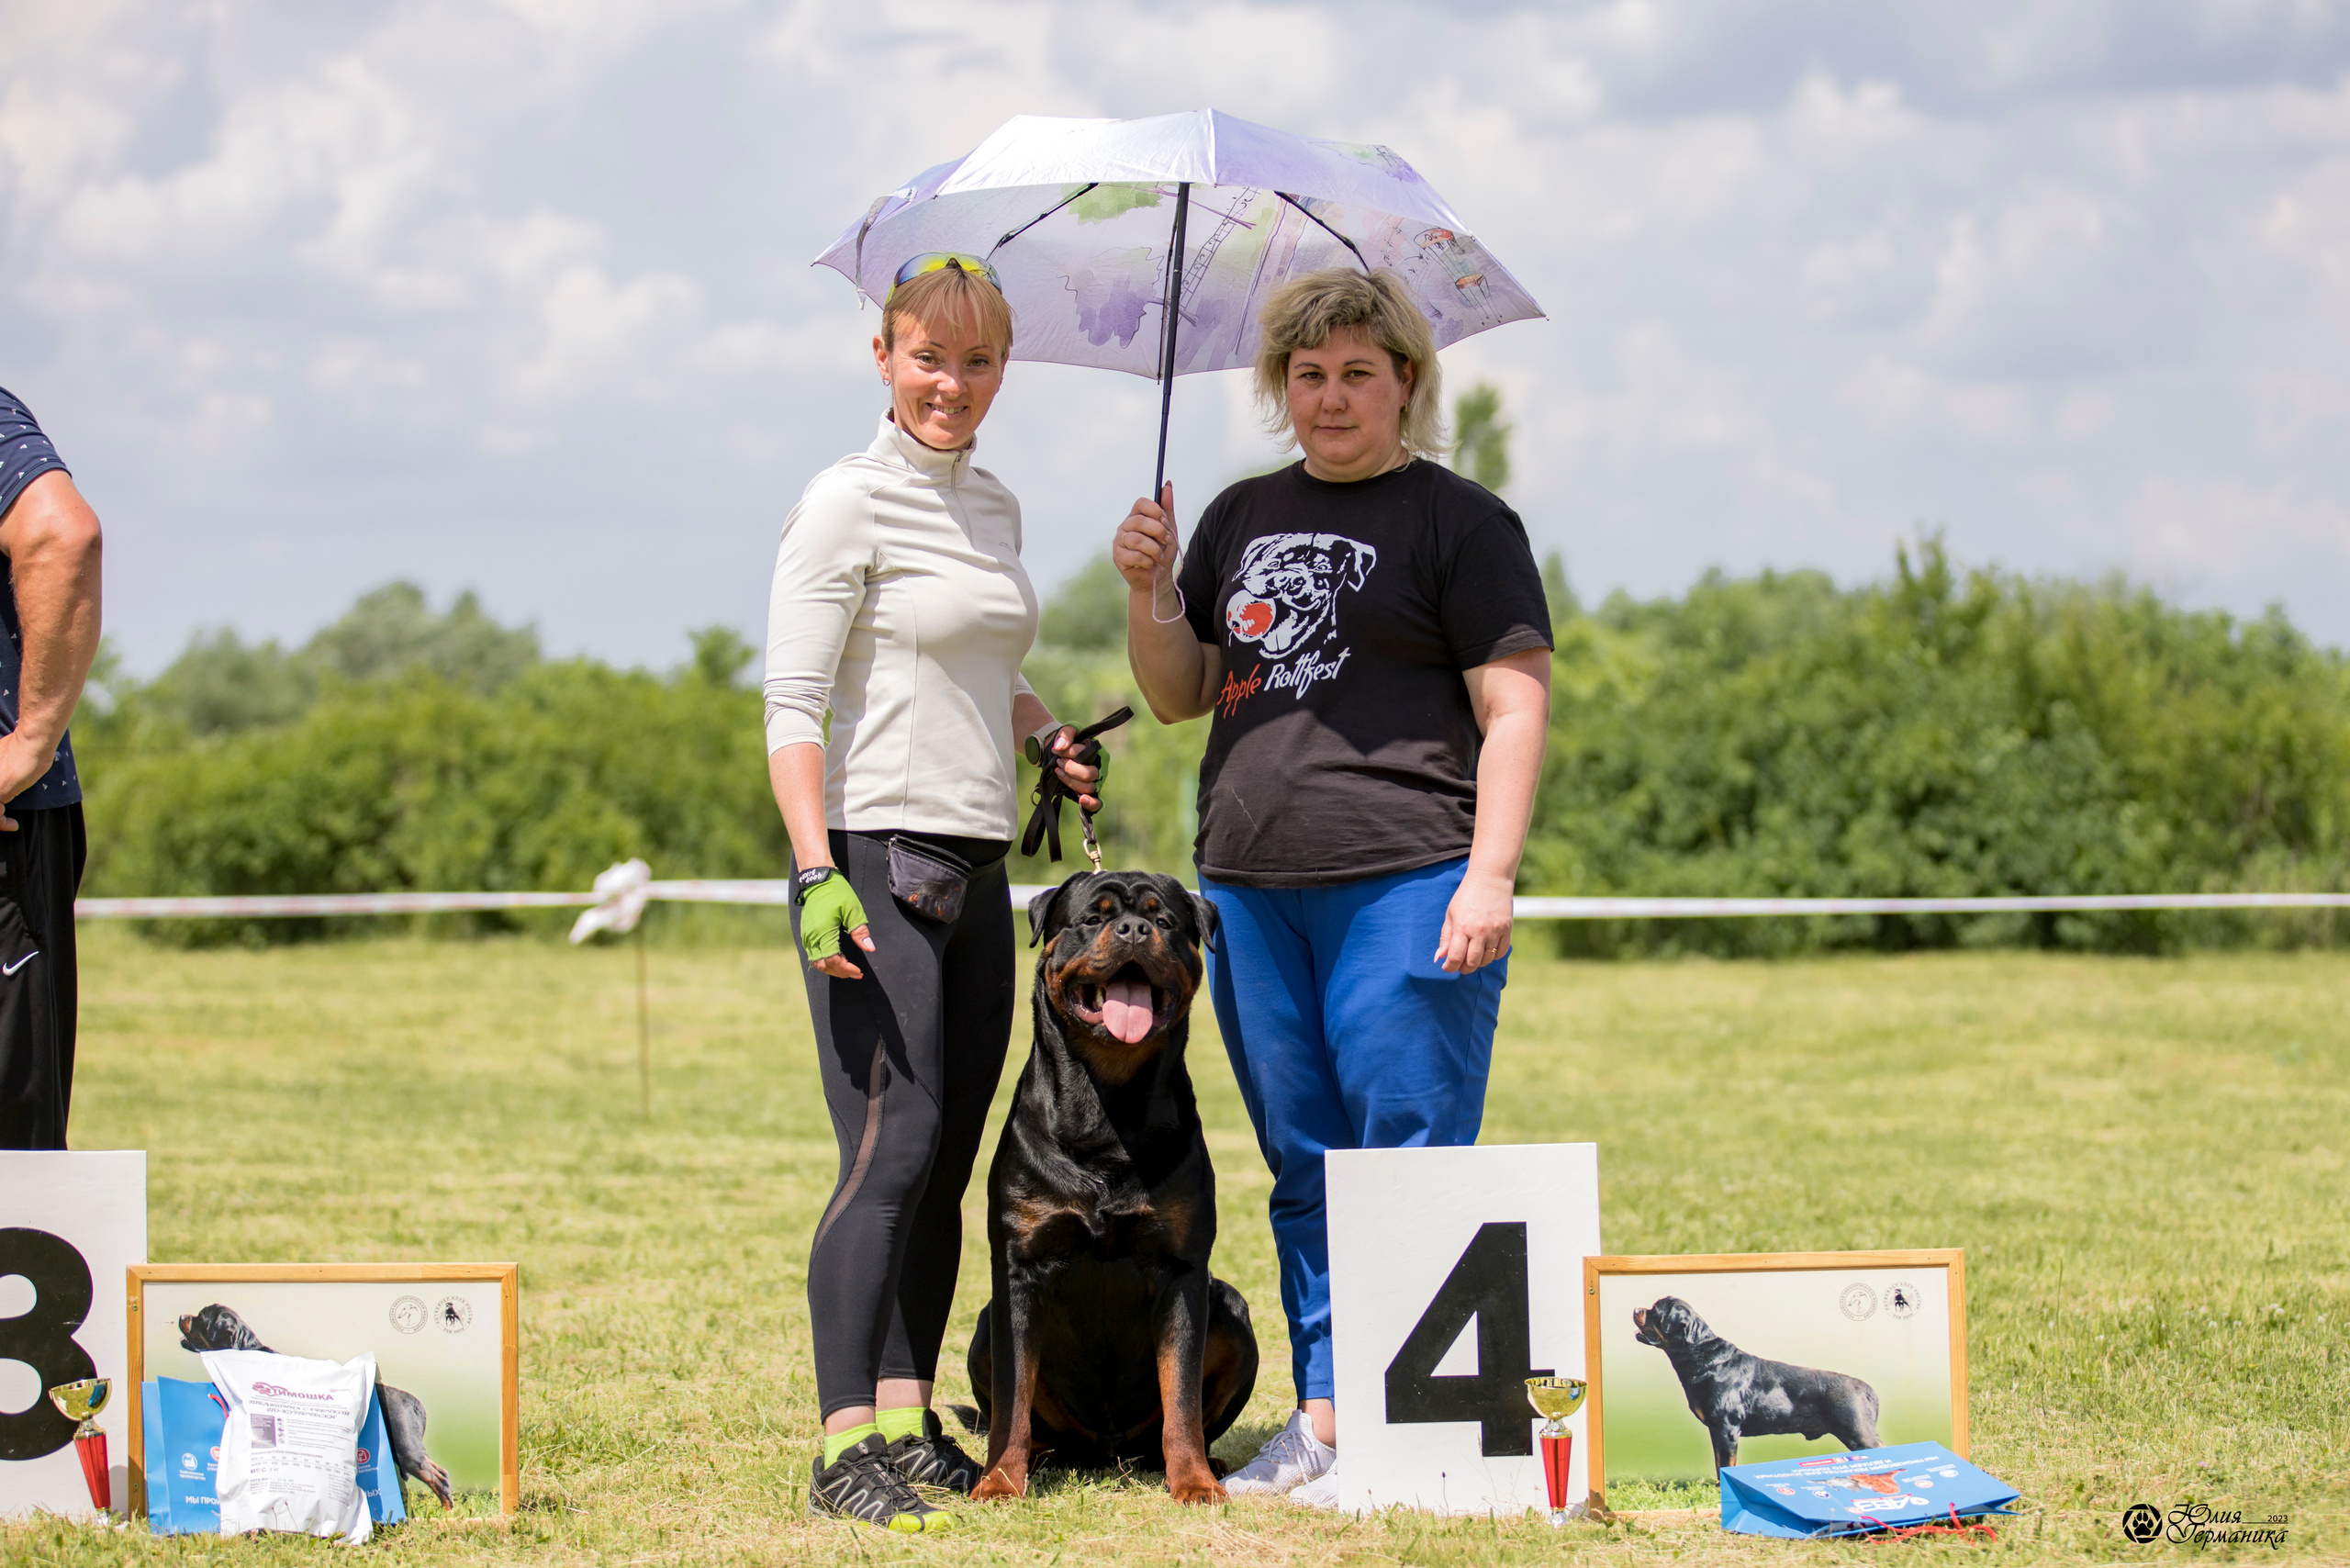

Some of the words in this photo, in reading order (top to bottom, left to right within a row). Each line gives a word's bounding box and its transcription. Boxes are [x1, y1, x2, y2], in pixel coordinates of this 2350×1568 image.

[1217, 664, 1262, 719] Apple
[1384, 1221, 1555, 1457] 4
[185, 1495, 200, 1505] МЫ
